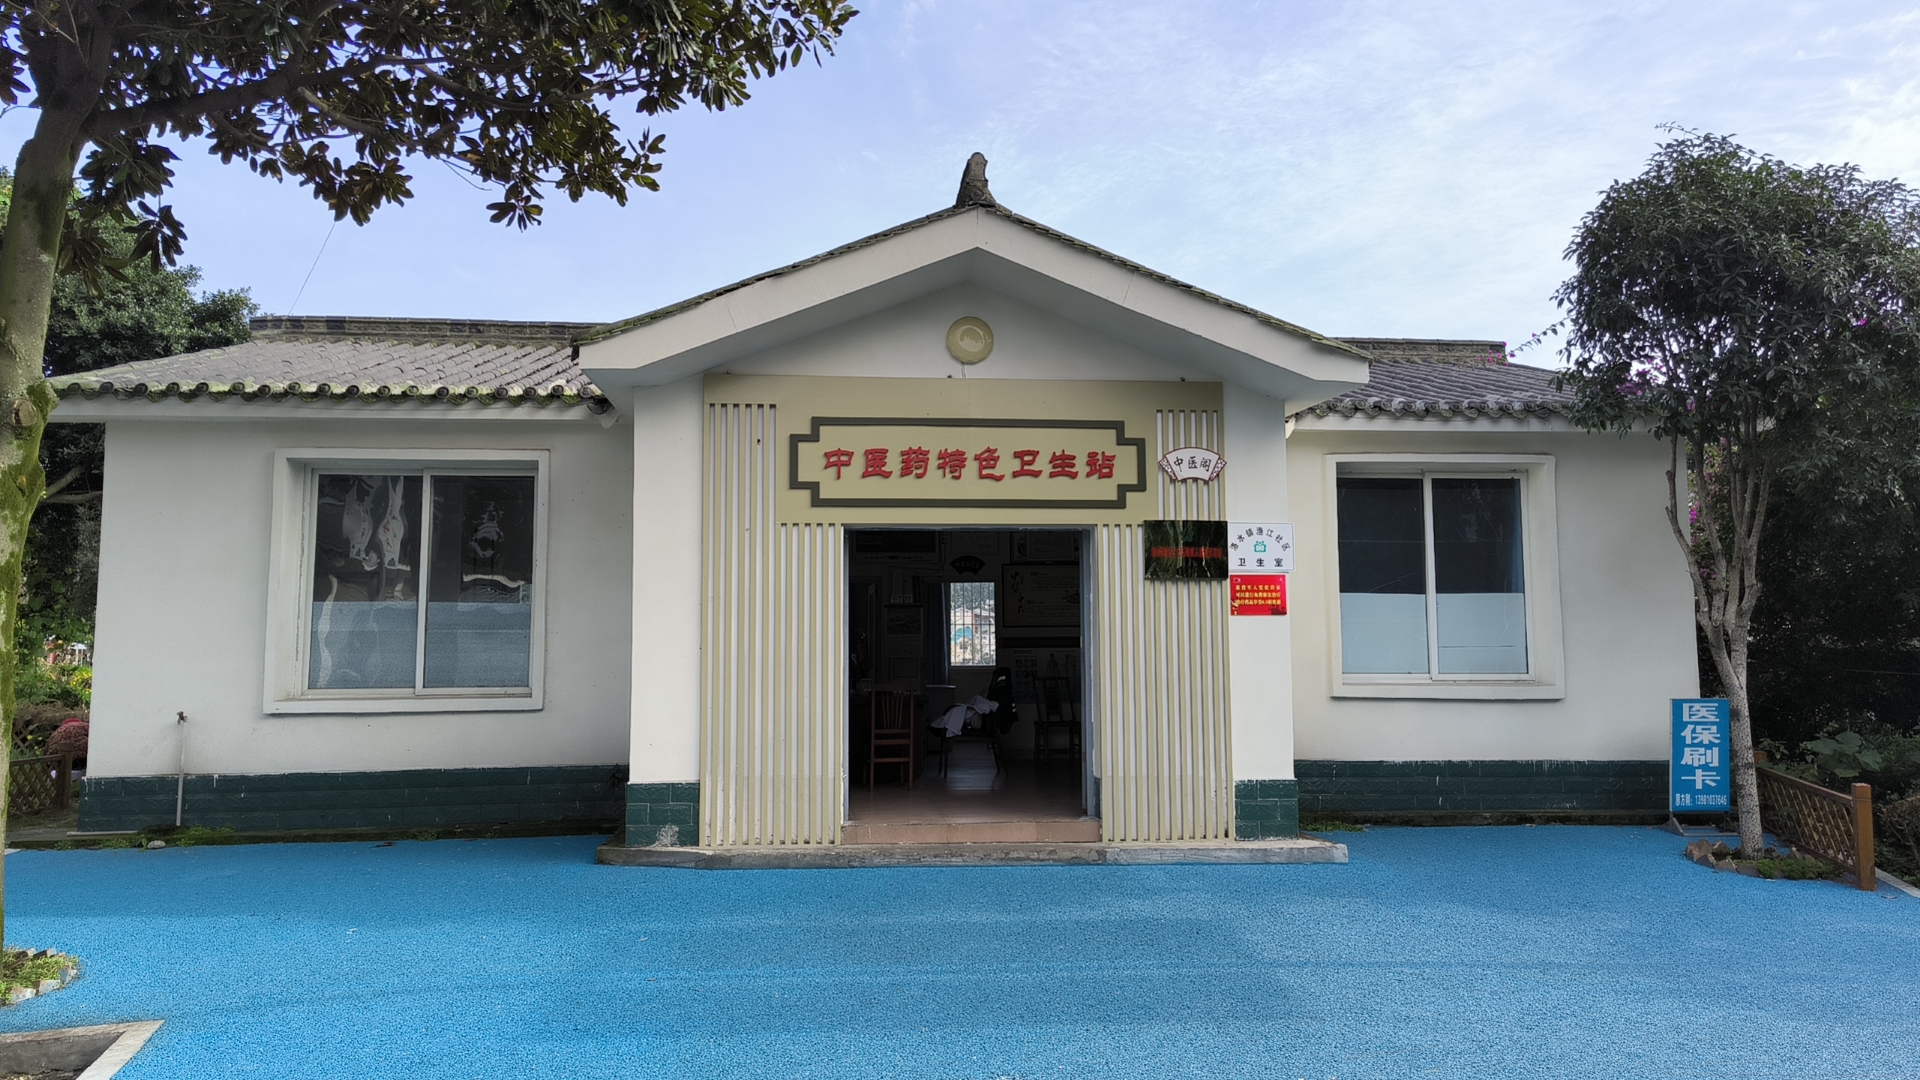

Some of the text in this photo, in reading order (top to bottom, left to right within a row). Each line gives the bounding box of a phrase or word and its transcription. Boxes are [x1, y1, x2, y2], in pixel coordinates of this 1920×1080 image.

[824, 446, 1116, 481] 中医药特色卫生站
[1173, 455, 1212, 472] 中医阁
[1237, 557, 1283, 568] 卫生室
[1680, 702, 1721, 790] 医保刷卡
